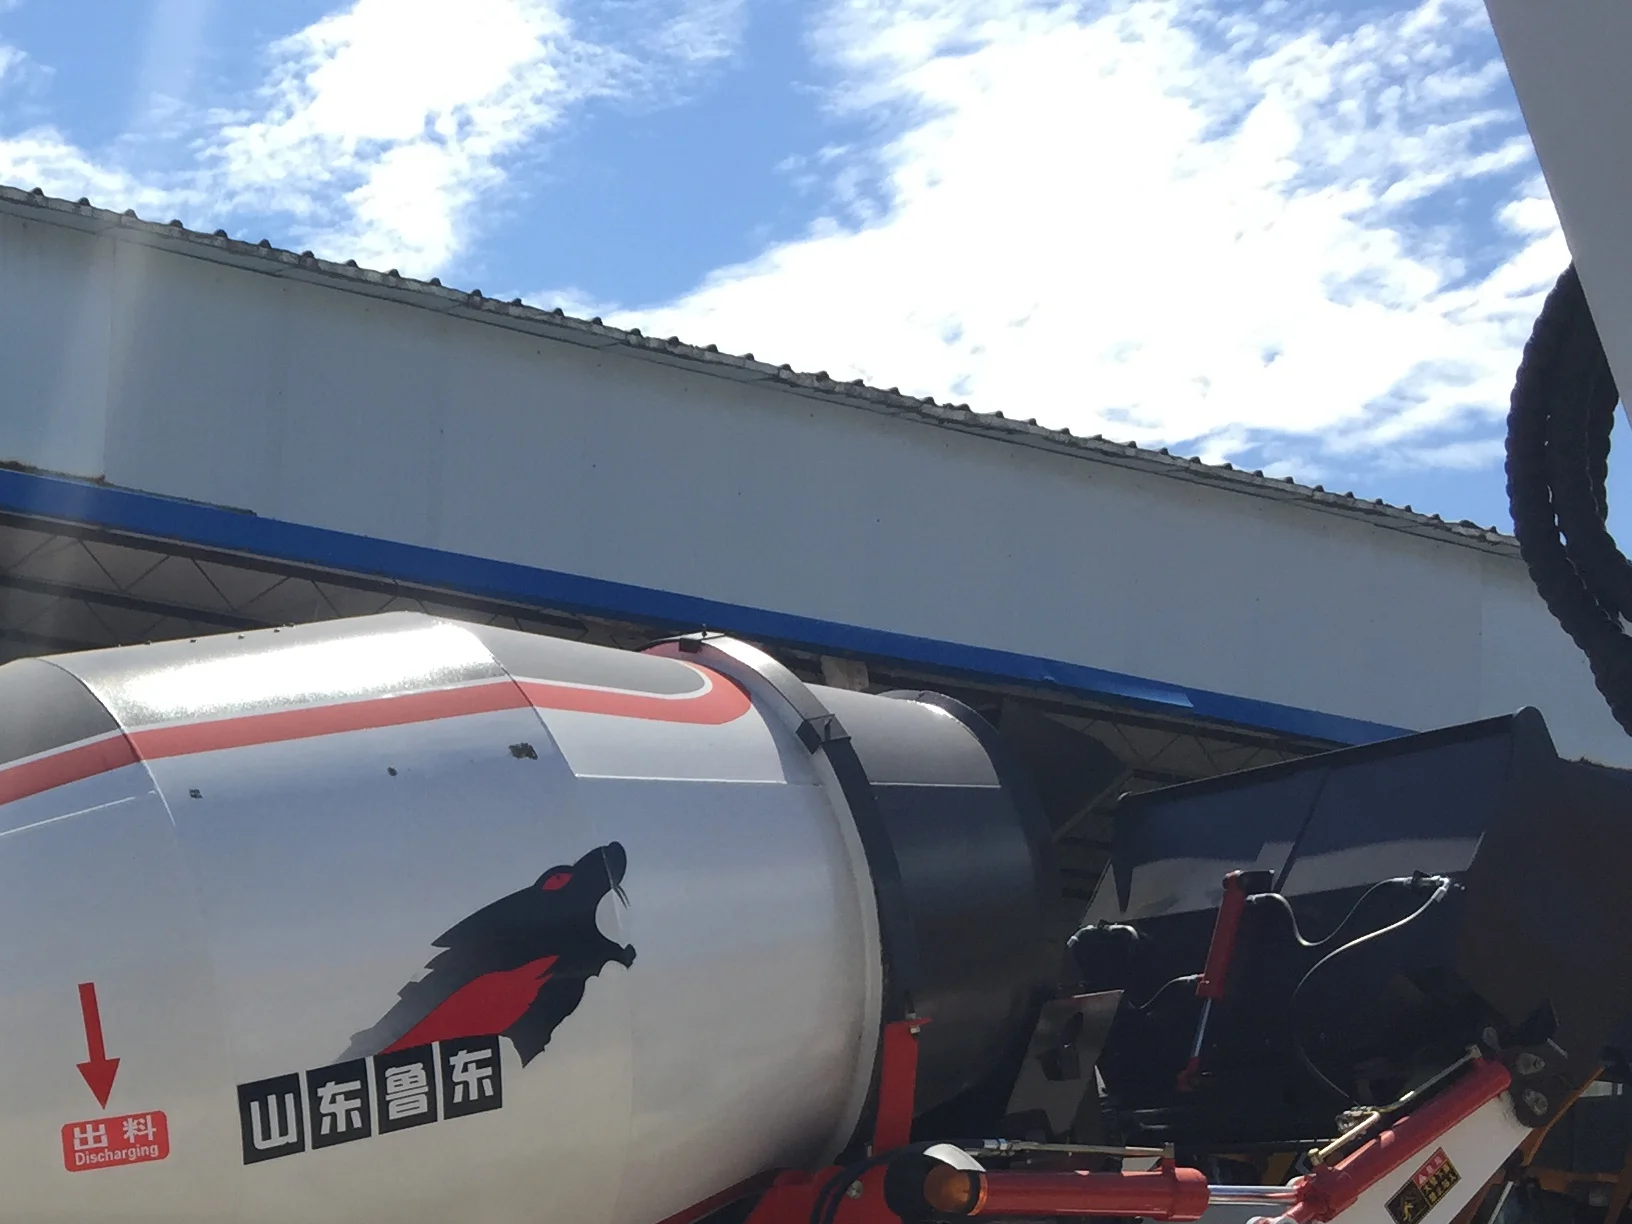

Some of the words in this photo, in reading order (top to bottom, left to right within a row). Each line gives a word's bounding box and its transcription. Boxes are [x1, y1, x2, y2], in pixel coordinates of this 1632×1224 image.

[249, 1048, 495, 1151] 山东鲁东
[73, 1114, 157, 1151] 出料
[74, 1143, 159, 1166] Discharging
